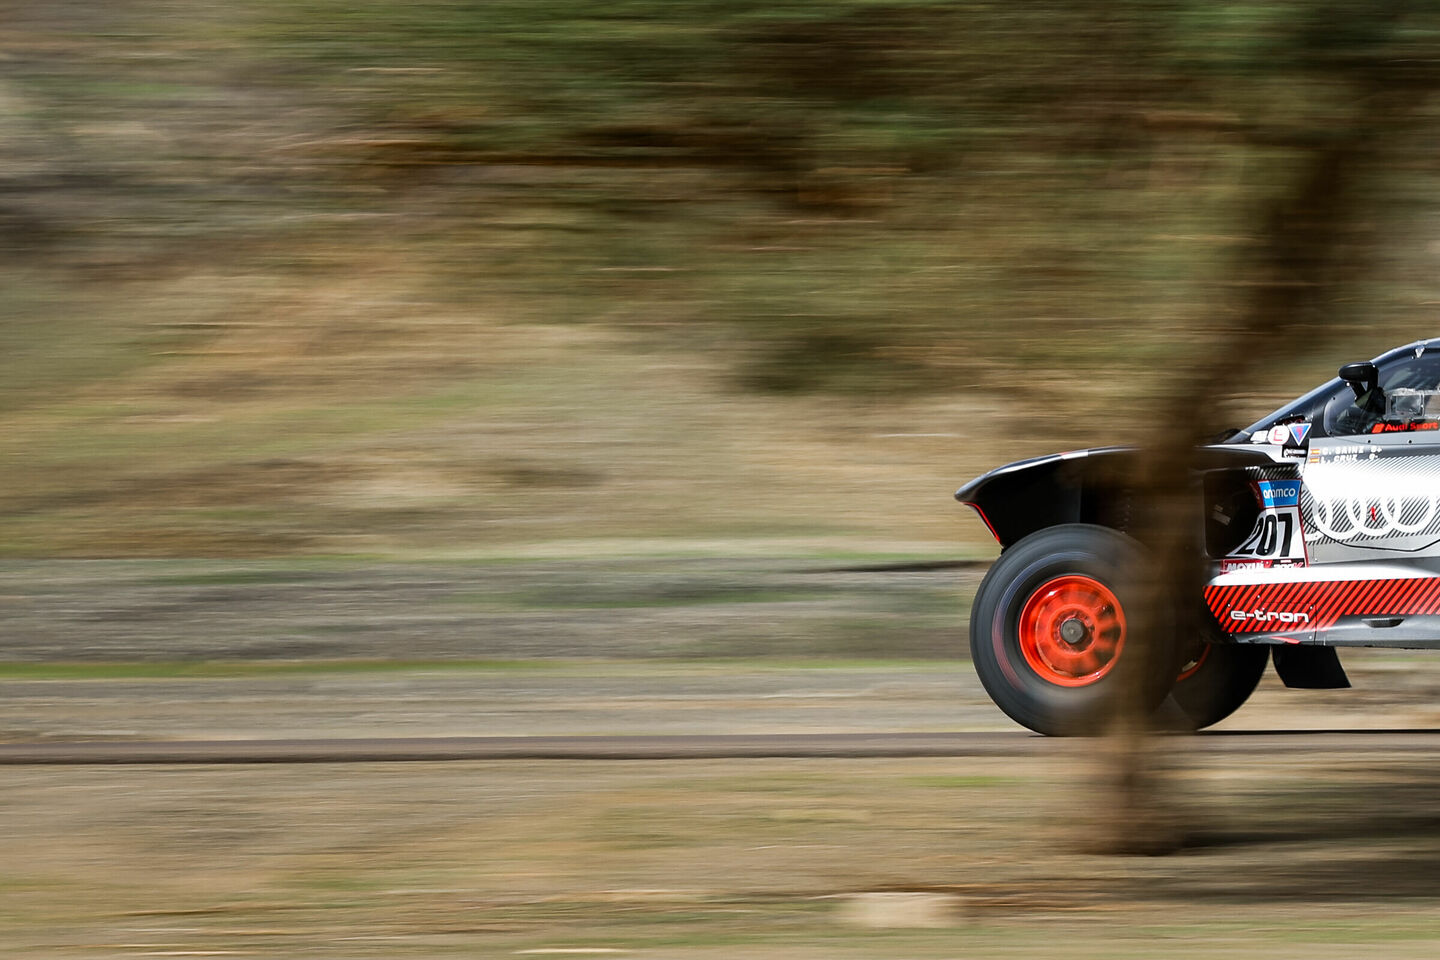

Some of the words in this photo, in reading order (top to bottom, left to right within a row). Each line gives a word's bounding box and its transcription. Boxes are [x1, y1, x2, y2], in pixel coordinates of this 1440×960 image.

[1385, 423, 1408, 431] Audi
[1410, 422, 1438, 430] Sport
[1335, 446, 1364, 454] SAINZ
[1263, 488, 1296, 498] aramco
[1234, 513, 1293, 557] 207
[1231, 610, 1309, 623] e-tron
